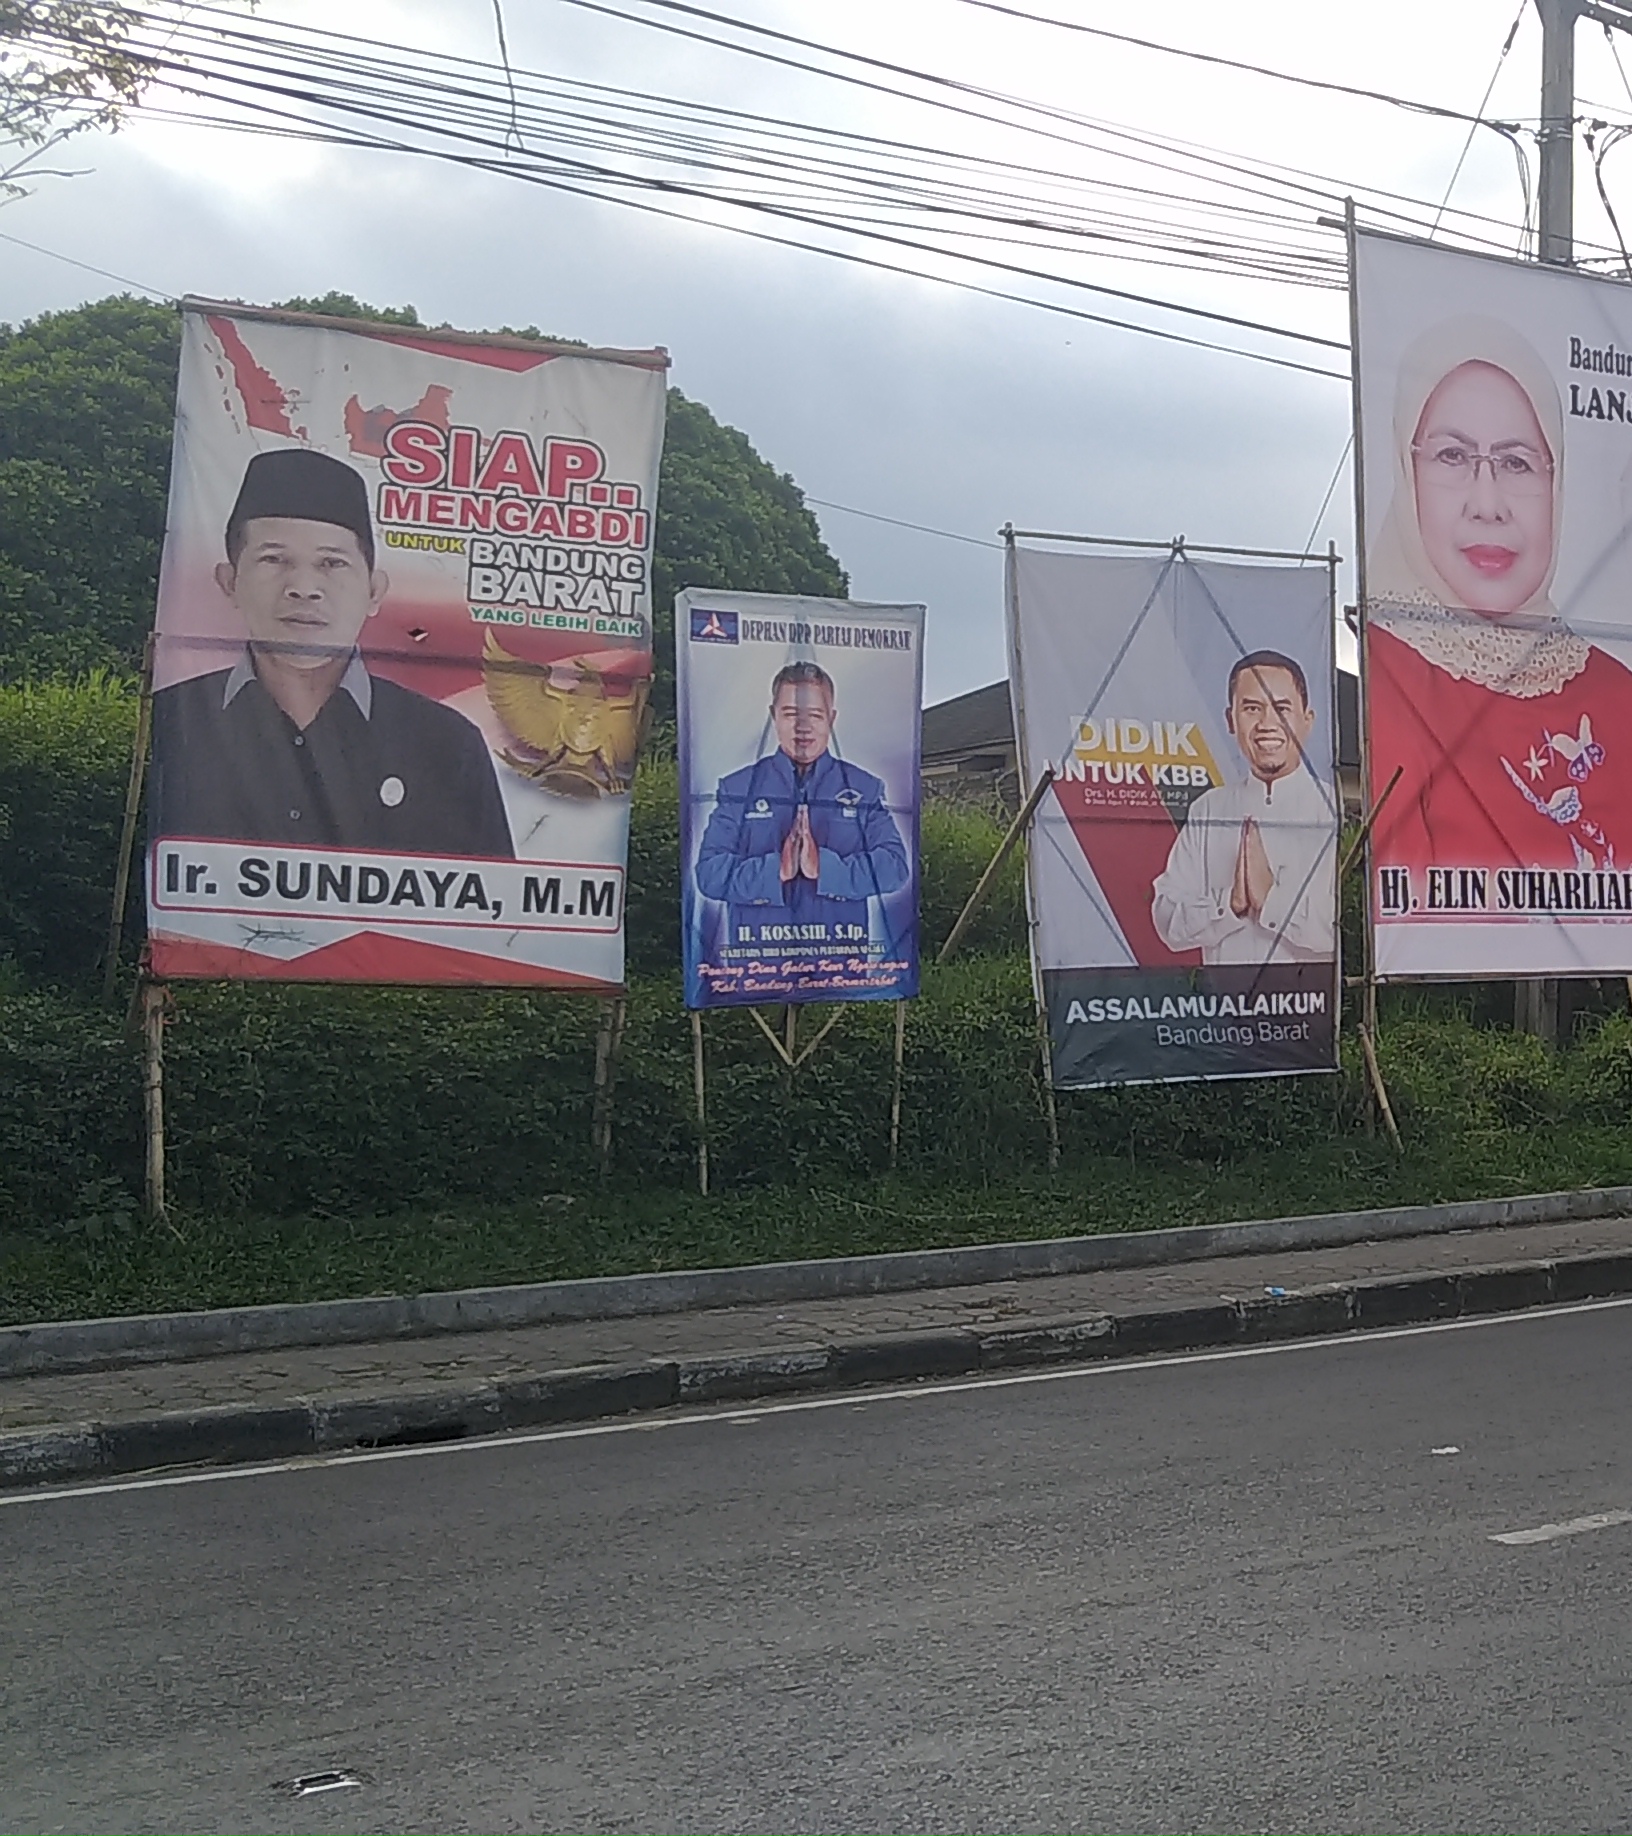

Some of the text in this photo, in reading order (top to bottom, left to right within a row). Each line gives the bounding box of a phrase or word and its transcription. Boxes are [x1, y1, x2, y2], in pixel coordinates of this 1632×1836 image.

[380, 484, 648, 549] MENGABDI
[386, 531, 645, 579] UNTUK BANDUNG
[469, 567, 643, 615] BARAT
[471, 605, 643, 636] YANG LEBIH BAIK
[854, 628, 912, 650] DEMOKRAT
[1070, 715, 1199, 757] DIDIK
[1152, 763, 1209, 787] KBB
[165, 852, 616, 921] Ir. SUNDAYA, M.M
[1379, 868, 1418, 913] Hj.
[1427, 868, 1487, 910] ELIN
[760, 924, 831, 942] KOSASIH,
[1065, 992, 1326, 1024] ASSALAMUALAIKUM
[1156, 1020, 1310, 1046] Bandung Barat
